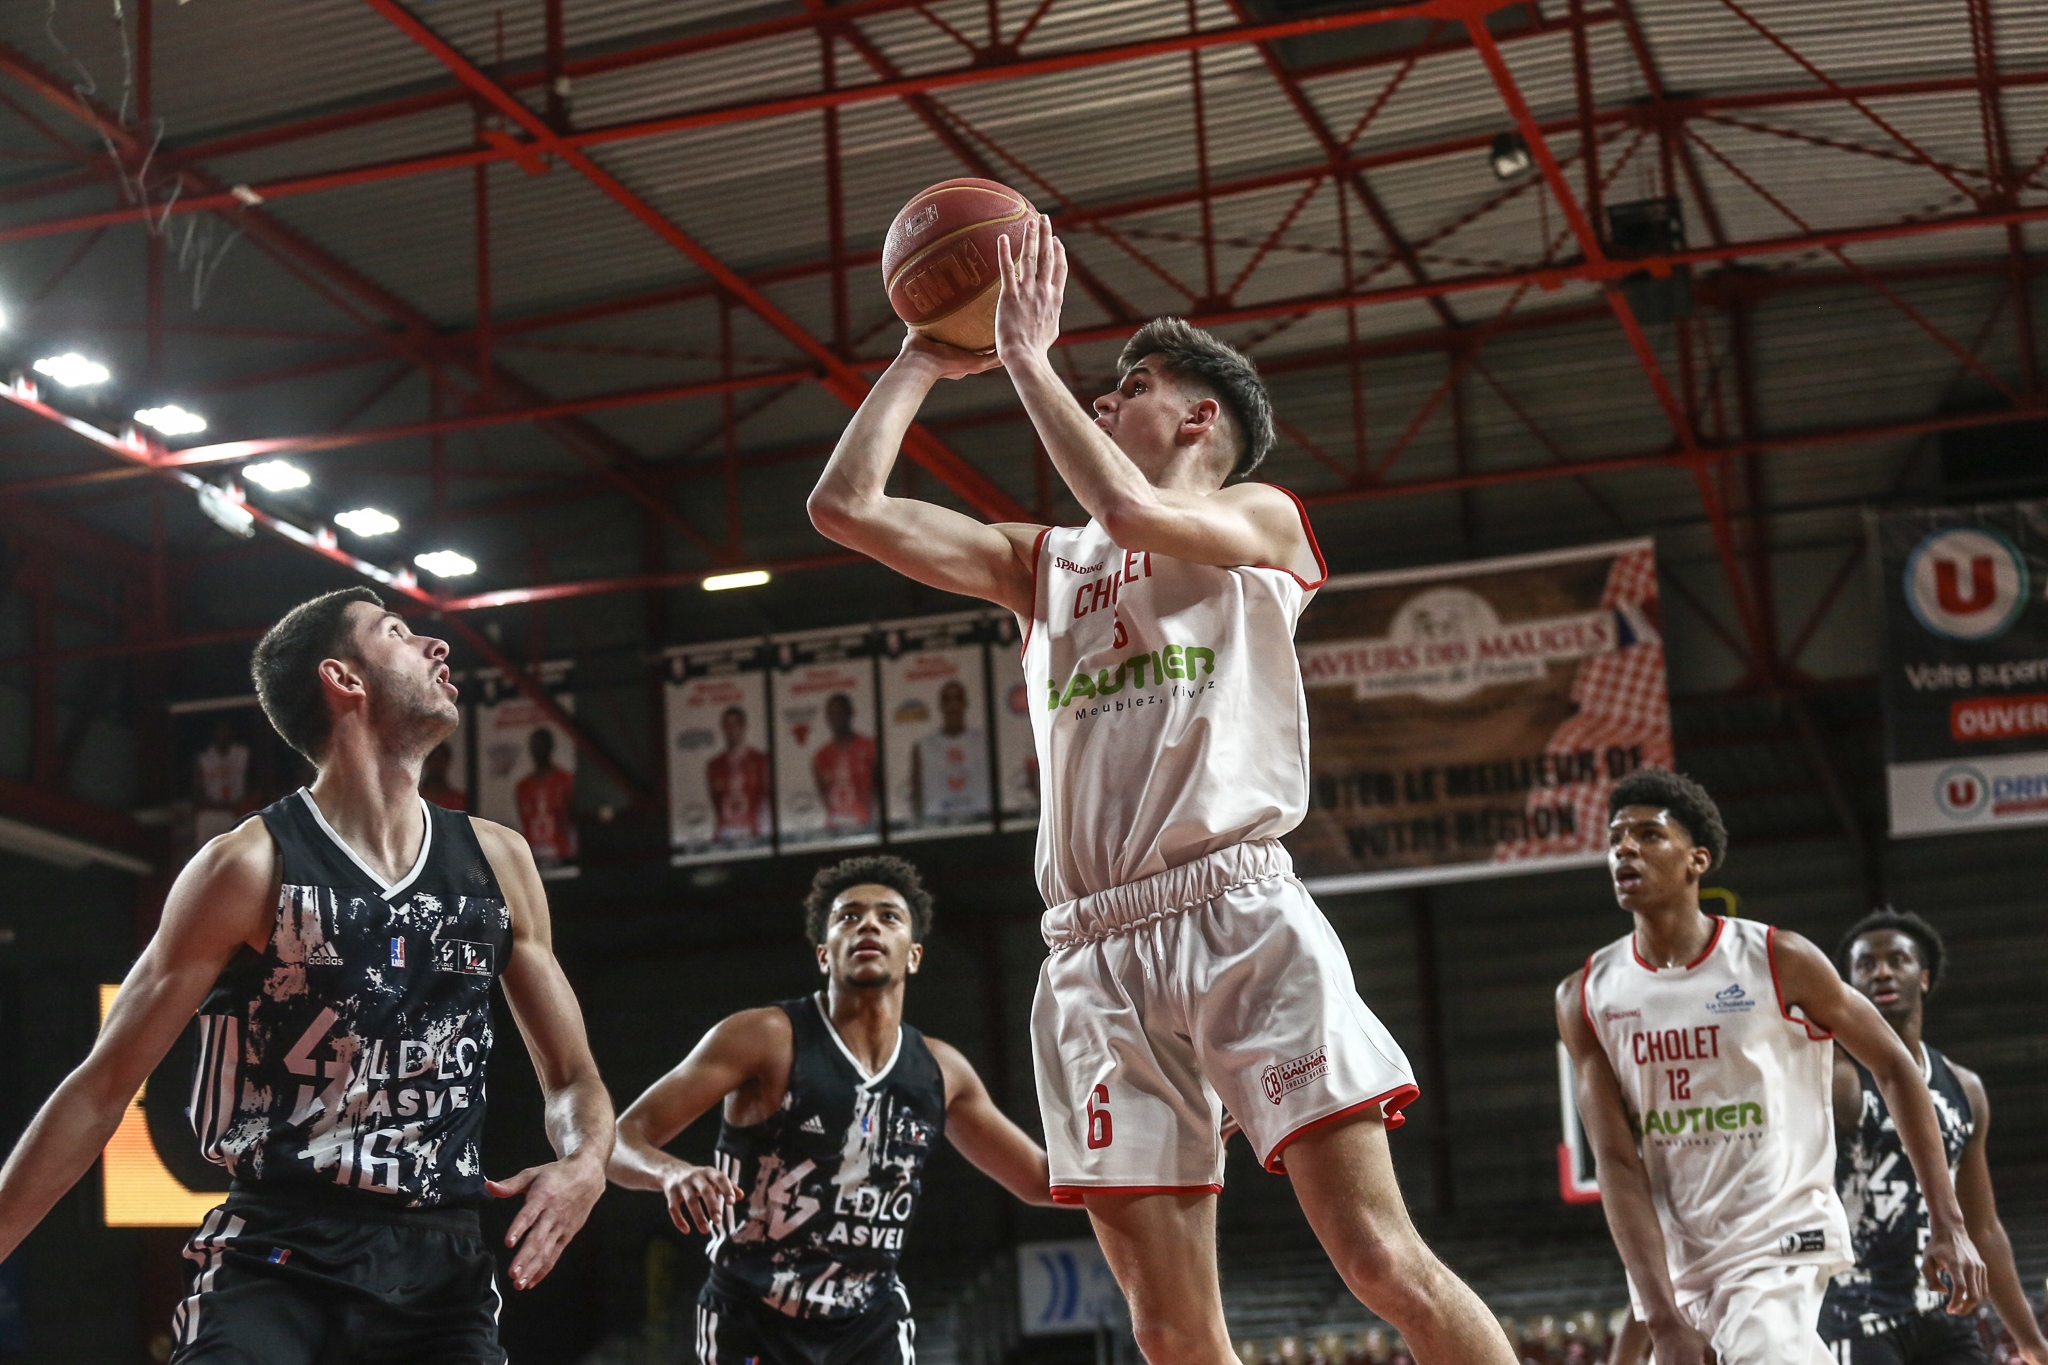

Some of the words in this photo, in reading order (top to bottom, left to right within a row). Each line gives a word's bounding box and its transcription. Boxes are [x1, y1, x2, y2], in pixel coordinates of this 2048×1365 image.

[1055, 557, 1103, 575] SPALDING
[1934, 556, 1997, 615] U
[1301, 644, 1419, 677] AVEURS
[1477, 620, 1607, 659] MAUGES
[1904, 662, 1973, 691] Votre
[1075, 694, 1163, 721] Meublez,
[1947, 778, 1977, 807] U
[308, 956, 344, 966] adidas
[369, 1036, 478, 1080] LDLC
[1633, 1025, 1720, 1065] CHOLET
[1282, 1054, 1327, 1081] GAUTIER
[1264, 1071, 1282, 1100] CB
[1285, 1076, 1307, 1090] CHOLET
[1666, 1068, 1692, 1101] 12
[366, 1086, 470, 1118] ASVE
[1087, 1083, 1113, 1150] 6
